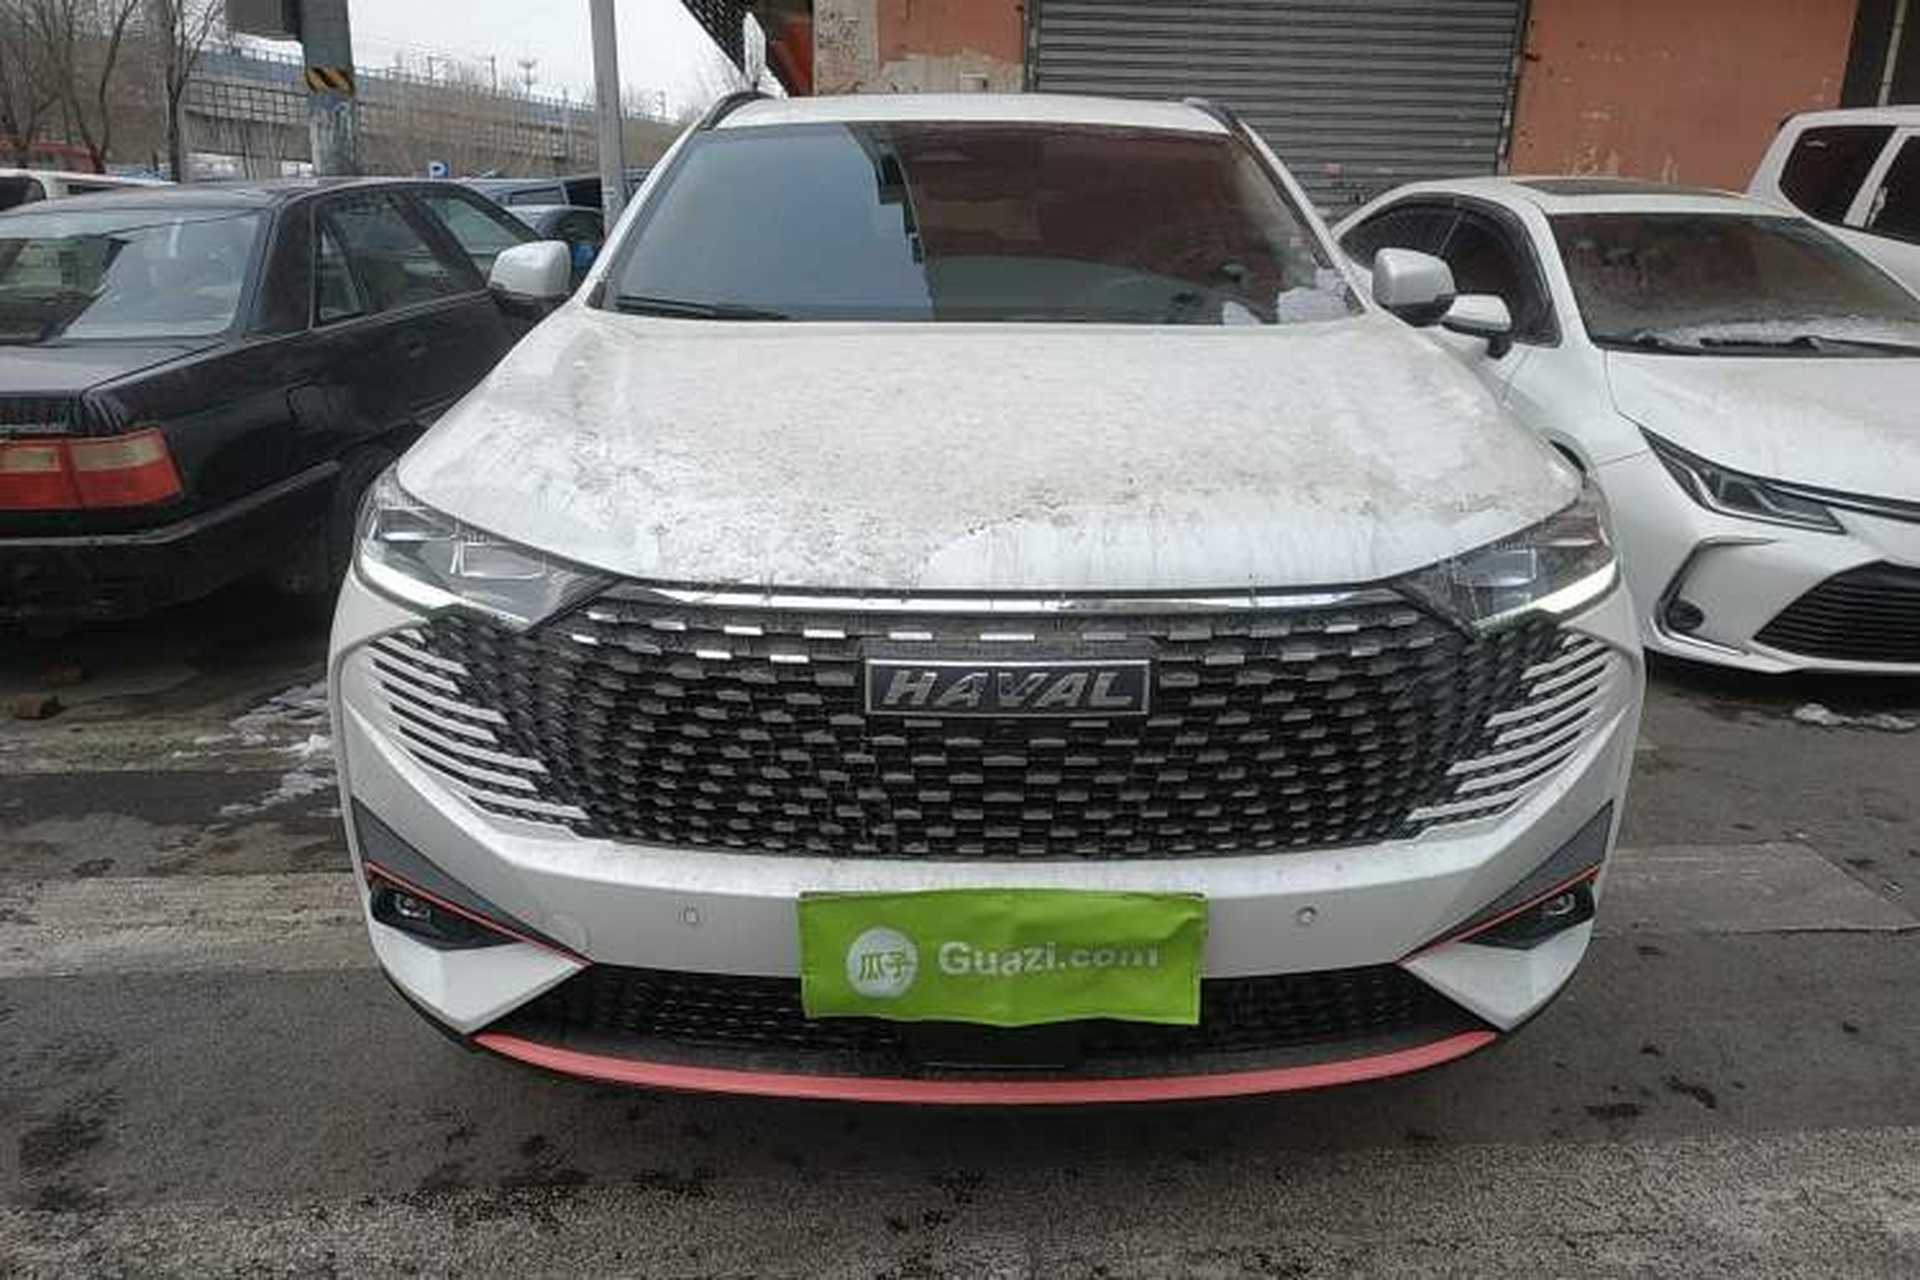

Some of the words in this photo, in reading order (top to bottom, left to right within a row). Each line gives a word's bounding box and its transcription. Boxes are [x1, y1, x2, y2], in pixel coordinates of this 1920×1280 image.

[429, 161, 445, 180] P
[882, 669, 1134, 708] HAVAL
[937, 939, 1160, 976] Guazi.com
